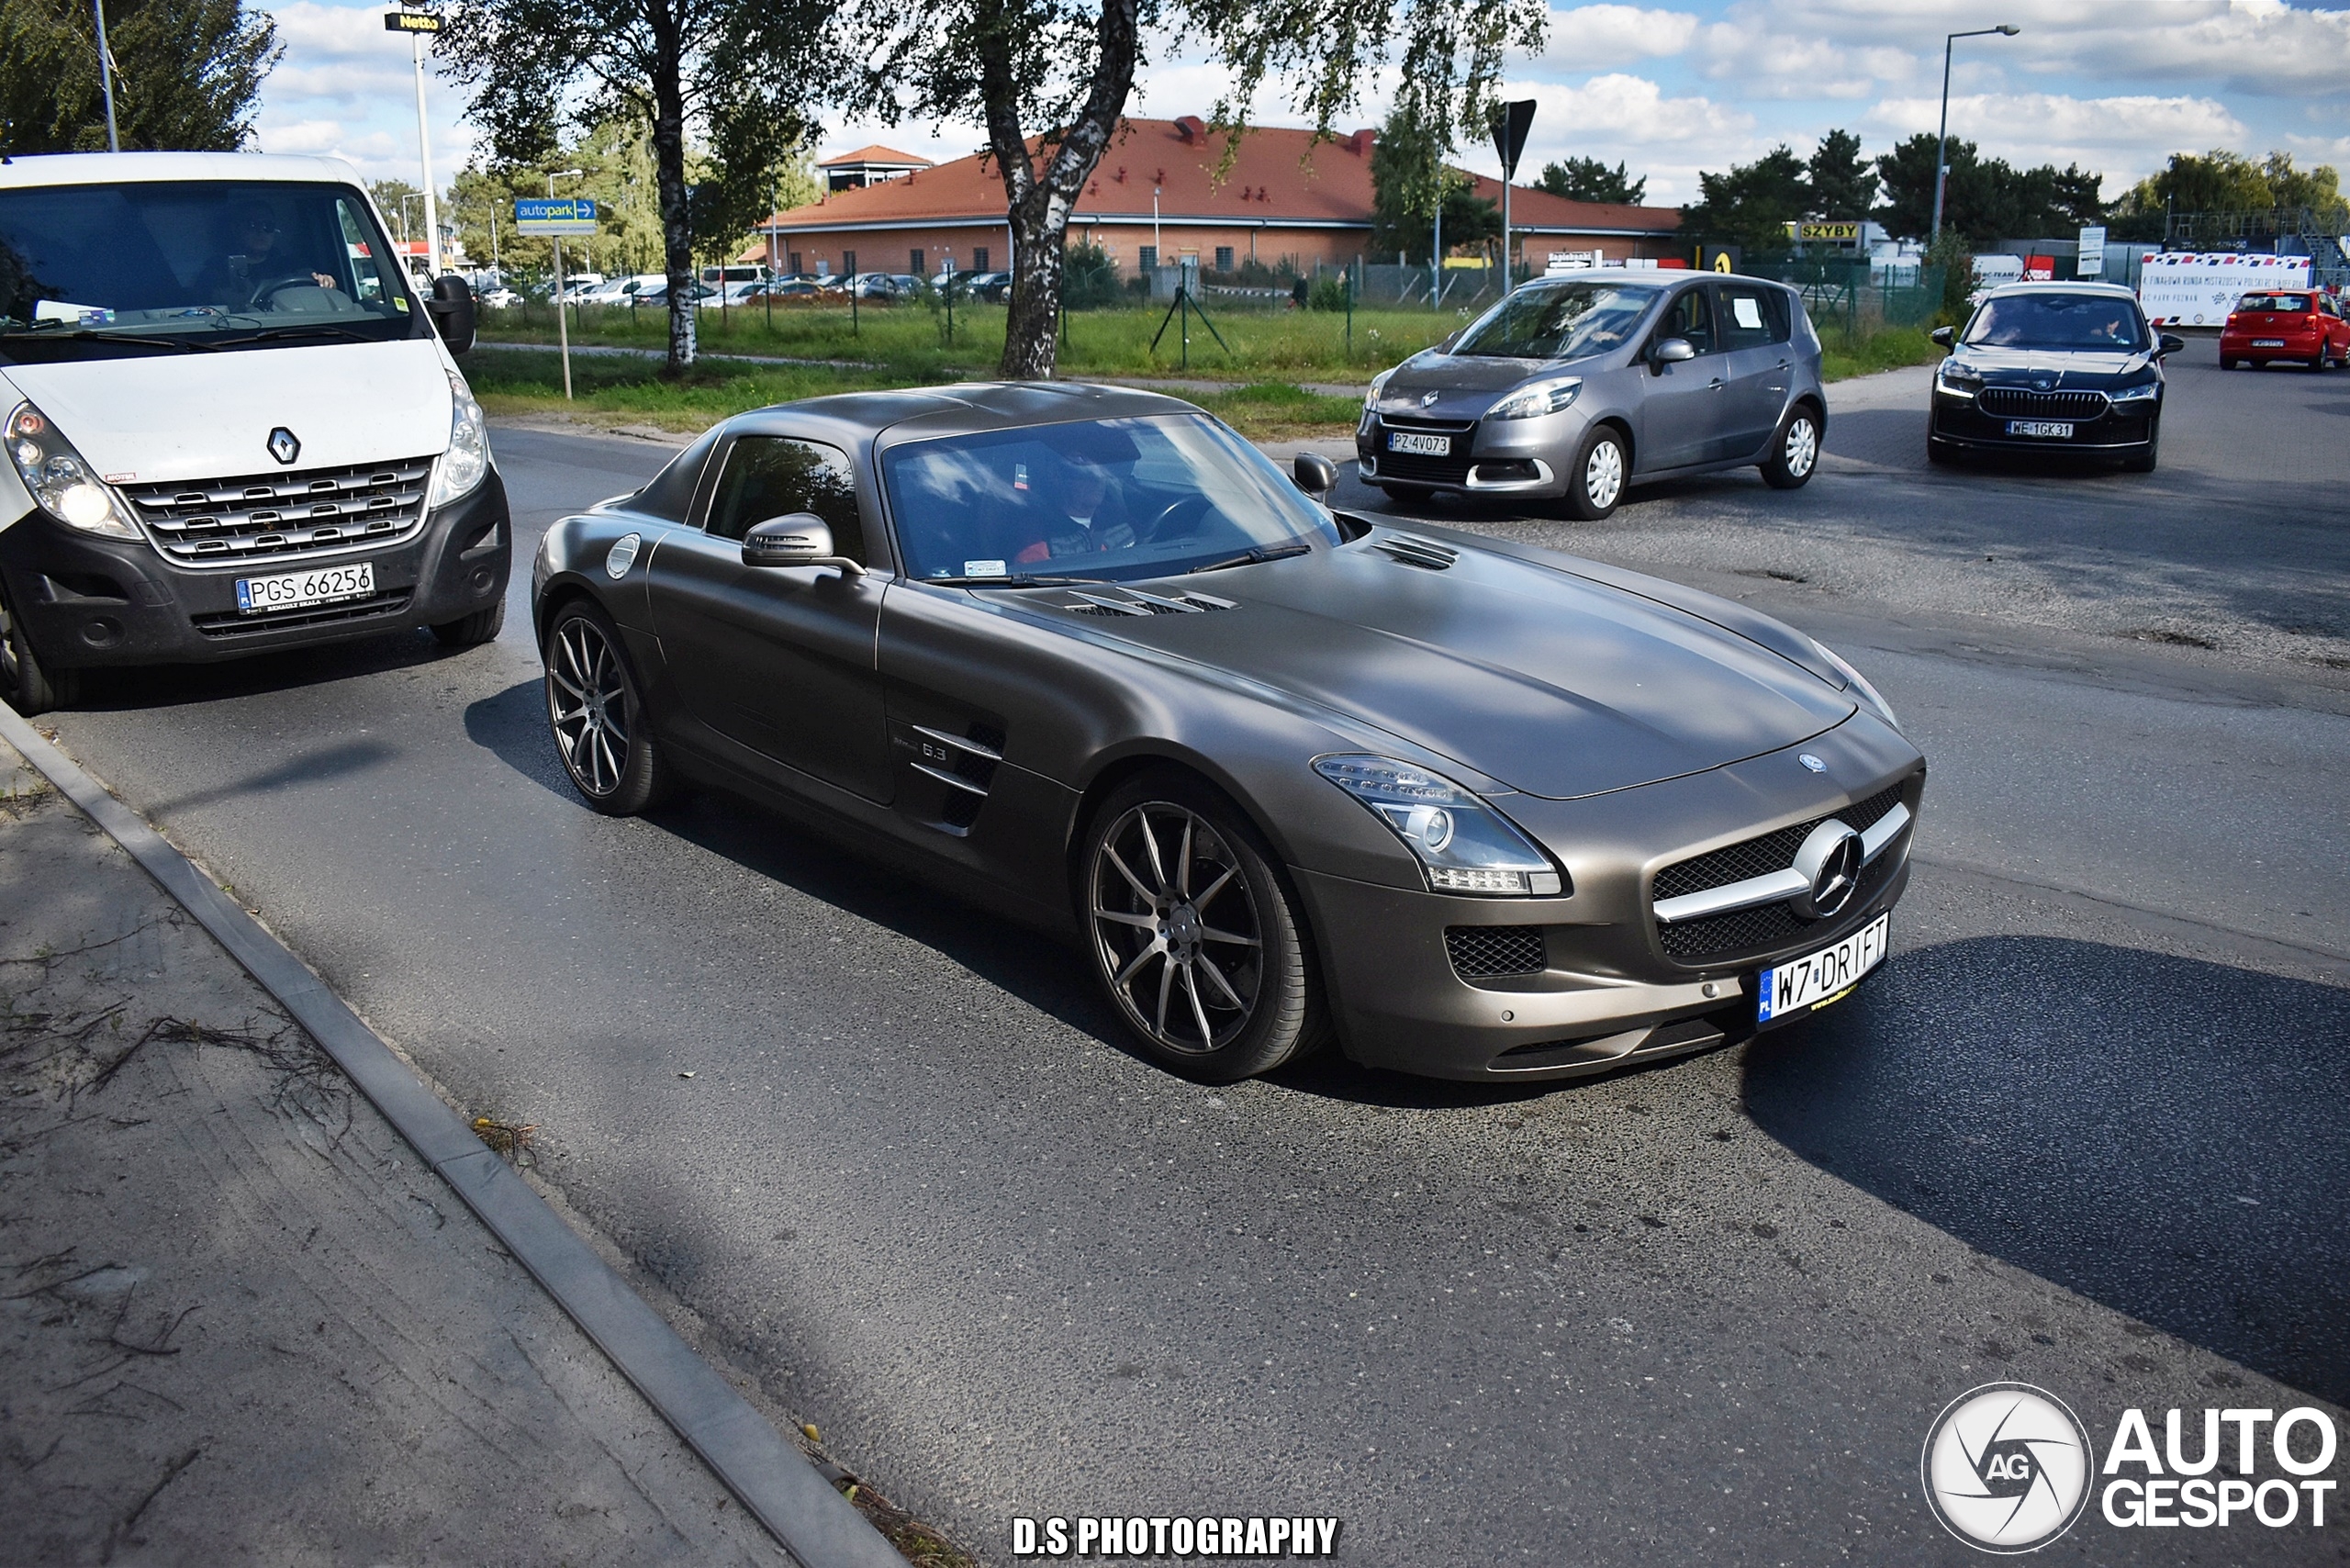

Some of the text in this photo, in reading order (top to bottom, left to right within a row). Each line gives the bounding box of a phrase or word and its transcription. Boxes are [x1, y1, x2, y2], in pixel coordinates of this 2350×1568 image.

[399, 15, 439, 29] Netto
[520, 205, 574, 218] autopark
[1802, 225, 1856, 237] SZYBY
[2013, 422, 2069, 436] WE 1GK31
[1394, 434, 1448, 452] PZ 4V073
[251, 567, 371, 604] PGS 66256
[266, 601, 298, 612] RENAULT
[923, 743, 946, 761] 6.3
[1778, 960, 1812, 1010] W7
[1820, 919, 1885, 992] DRIFT
[1759, 1002, 1771, 1014] PL
